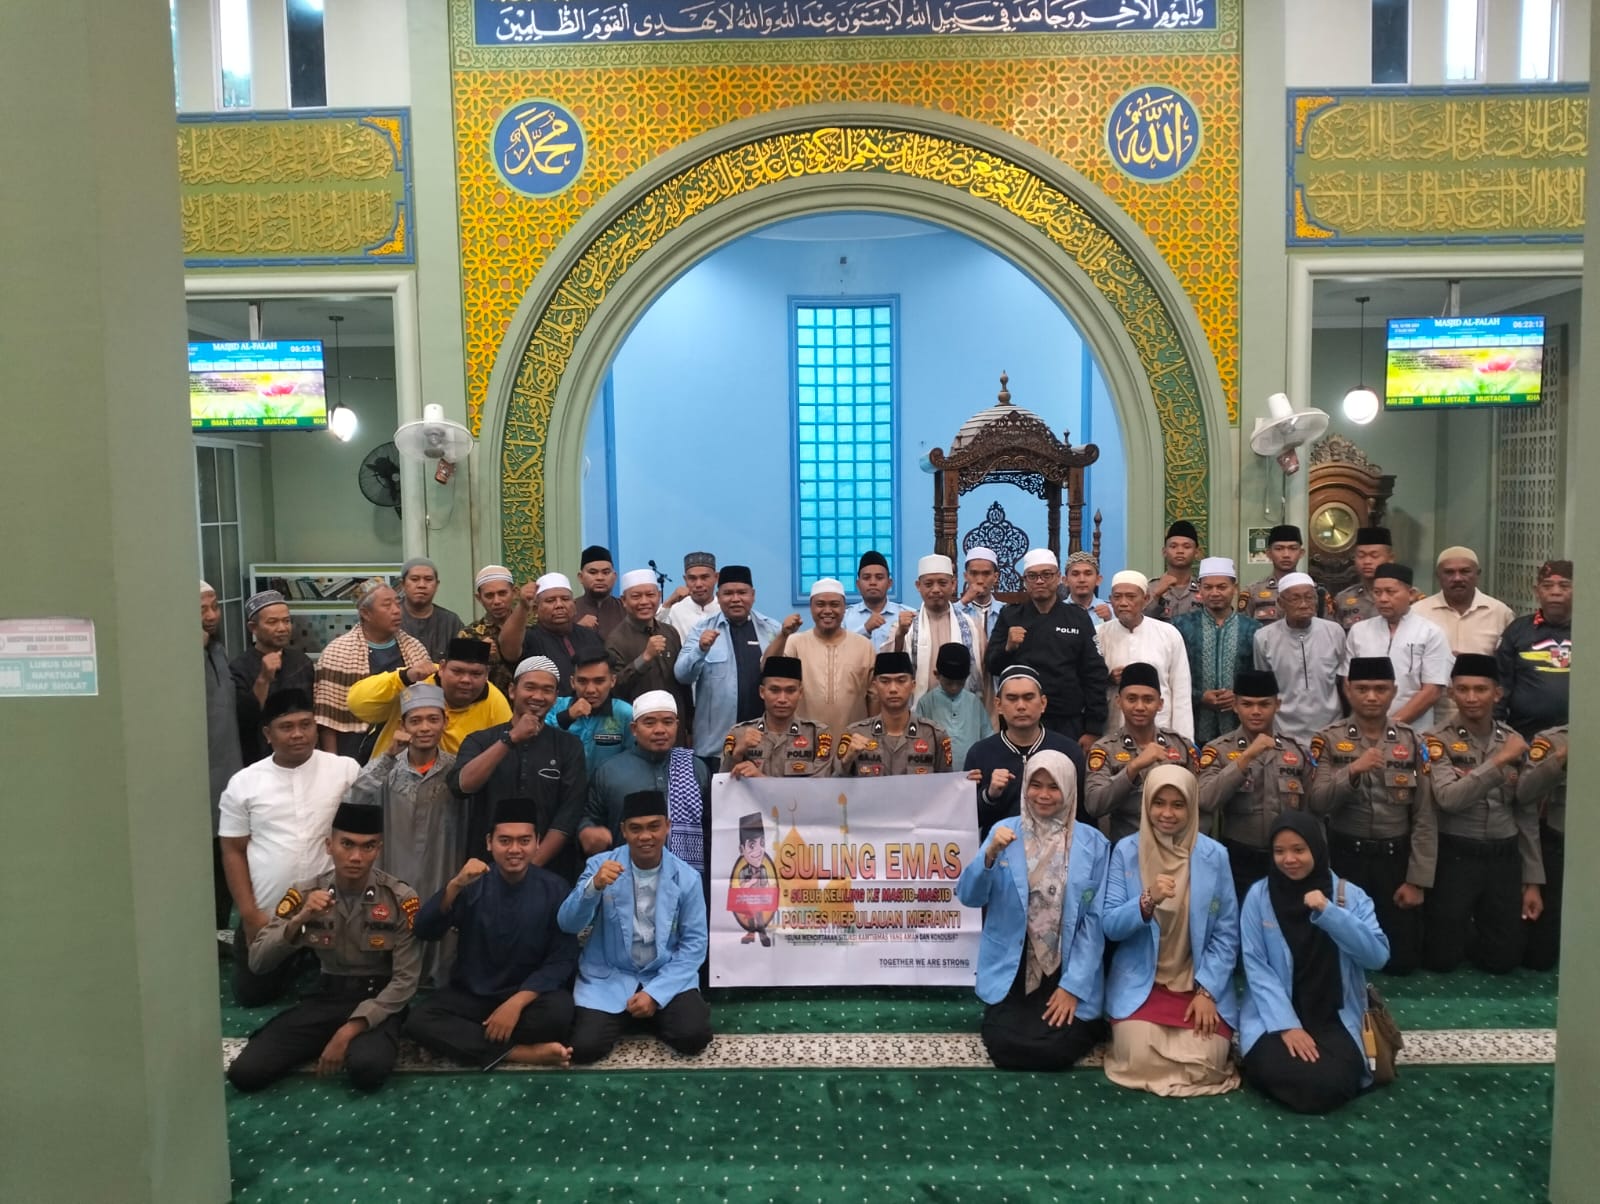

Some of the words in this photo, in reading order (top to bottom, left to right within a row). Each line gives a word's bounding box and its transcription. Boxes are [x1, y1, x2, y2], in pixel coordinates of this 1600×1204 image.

[1463, 317, 1500, 327] AL-FALAH
[1055, 626, 1080, 635] POLRI
[779, 842, 877, 881] SULING
[885, 842, 963, 880] EMAS
[790, 888, 822, 903] SUBUH
[823, 888, 865, 903] KELILING
[867, 888, 880, 902] KE
[881, 888, 952, 903] MASJID-MASJID
[782, 911, 829, 929] POLRES
[831, 910, 904, 929] KEPULAUAN
[906, 910, 961, 929] MERANTI
[879, 958, 914, 966] TOGETHER
[915, 958, 926, 966] WE
[927, 958, 941, 966] ARE
[942, 958, 970, 966] STRONG
